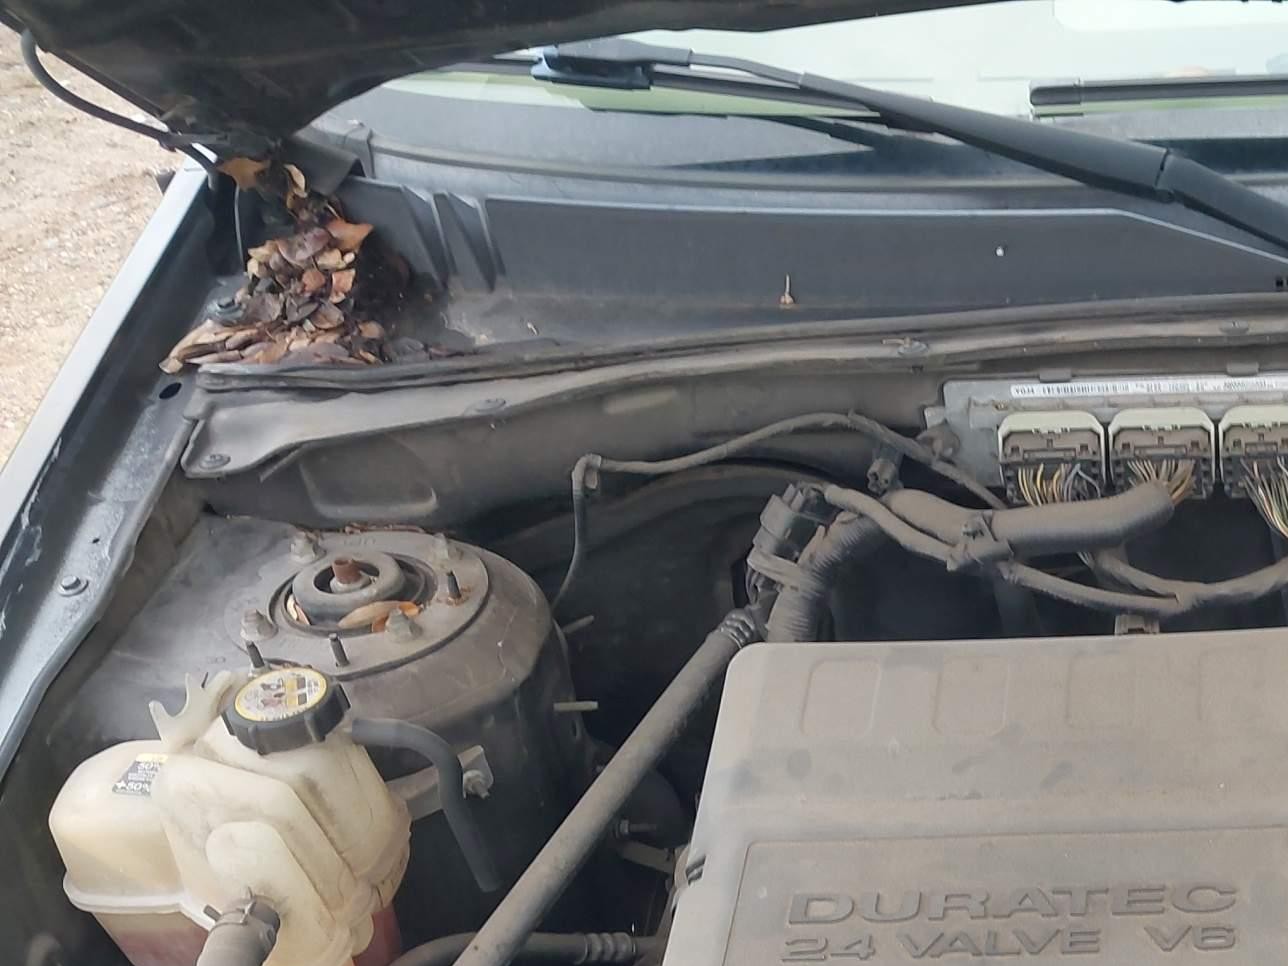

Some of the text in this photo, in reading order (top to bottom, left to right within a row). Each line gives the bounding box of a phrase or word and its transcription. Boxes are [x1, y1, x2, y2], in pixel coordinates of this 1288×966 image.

[787, 883, 1239, 925] DURATEC
[781, 924, 1238, 963] 24 VALVE V6
